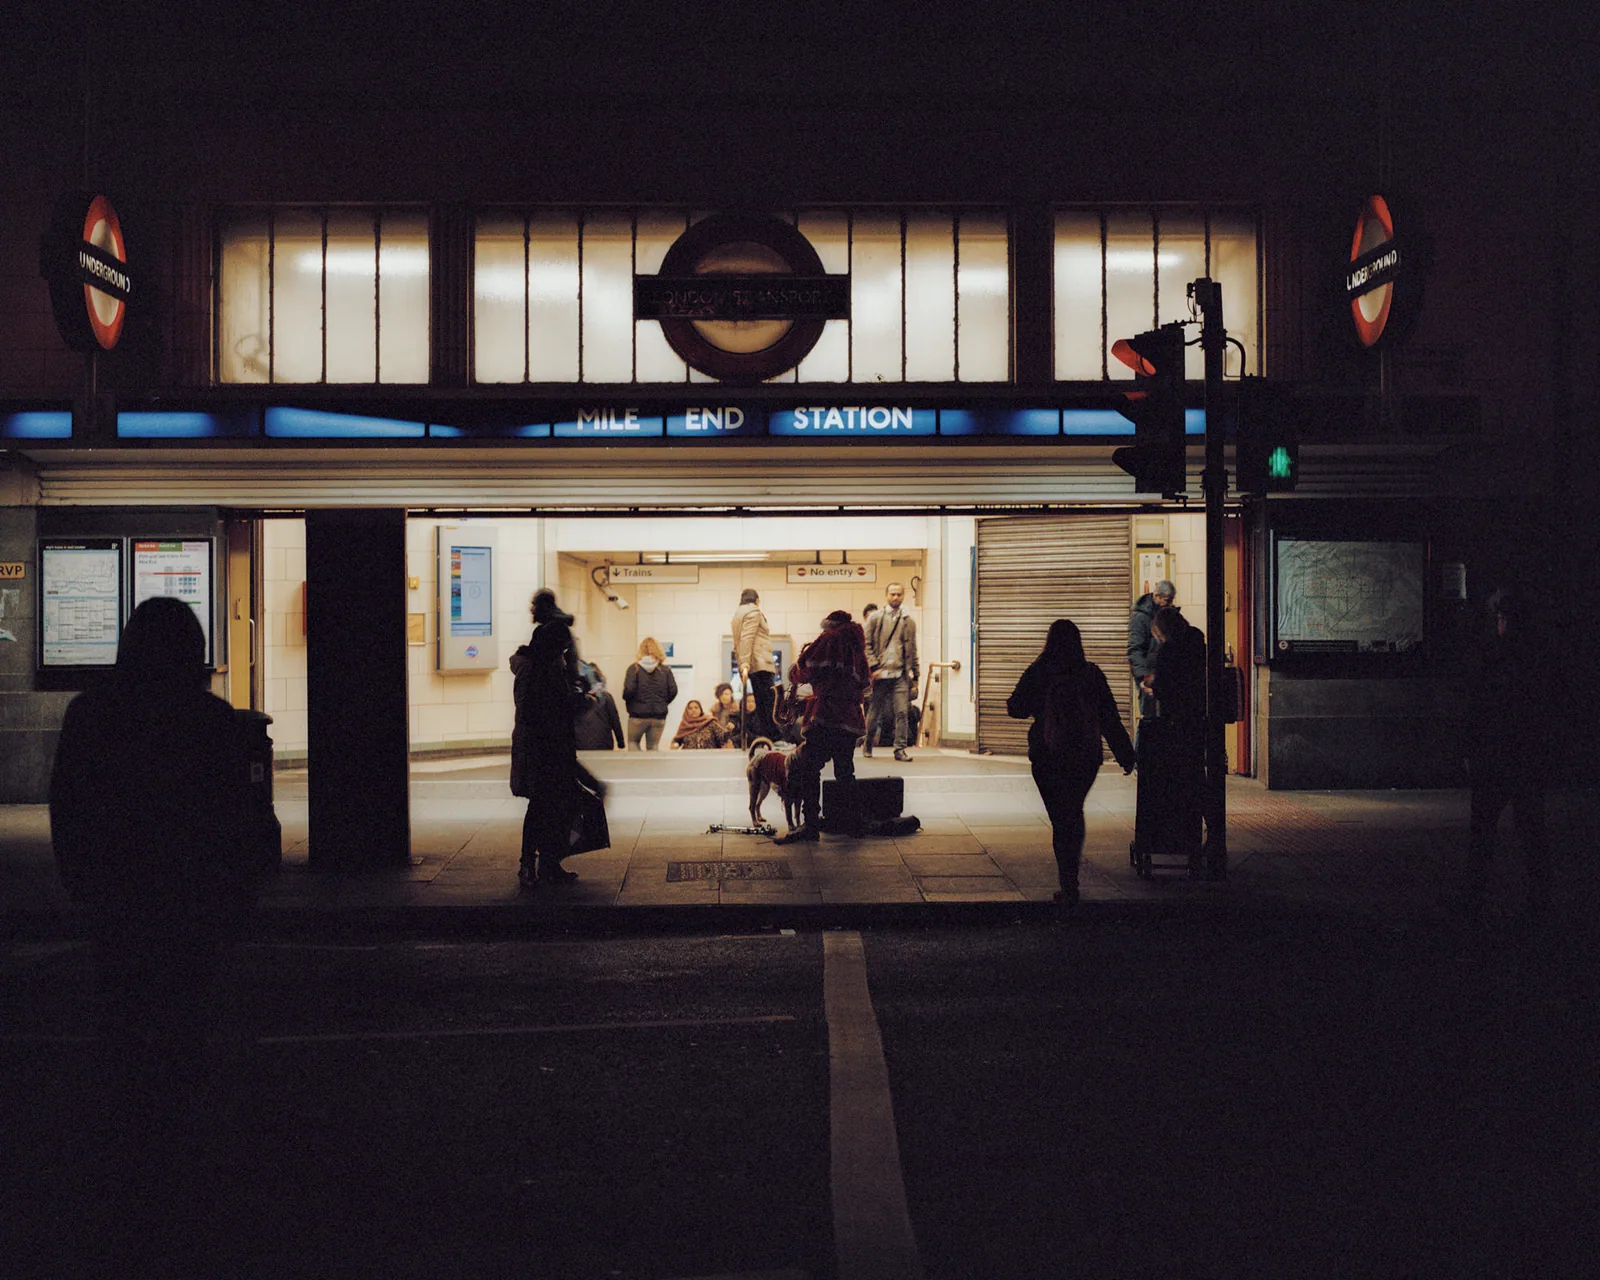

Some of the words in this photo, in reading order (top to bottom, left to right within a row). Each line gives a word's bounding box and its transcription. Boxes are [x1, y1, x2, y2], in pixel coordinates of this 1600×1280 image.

[79, 250, 132, 293] UNDERGROUND
[576, 407, 640, 431] MILE
[685, 407, 744, 431] END
[793, 406, 913, 430] STATION
[624, 567, 652, 577] Trains
[810, 567, 825, 577] No
[828, 567, 853, 579] entry
